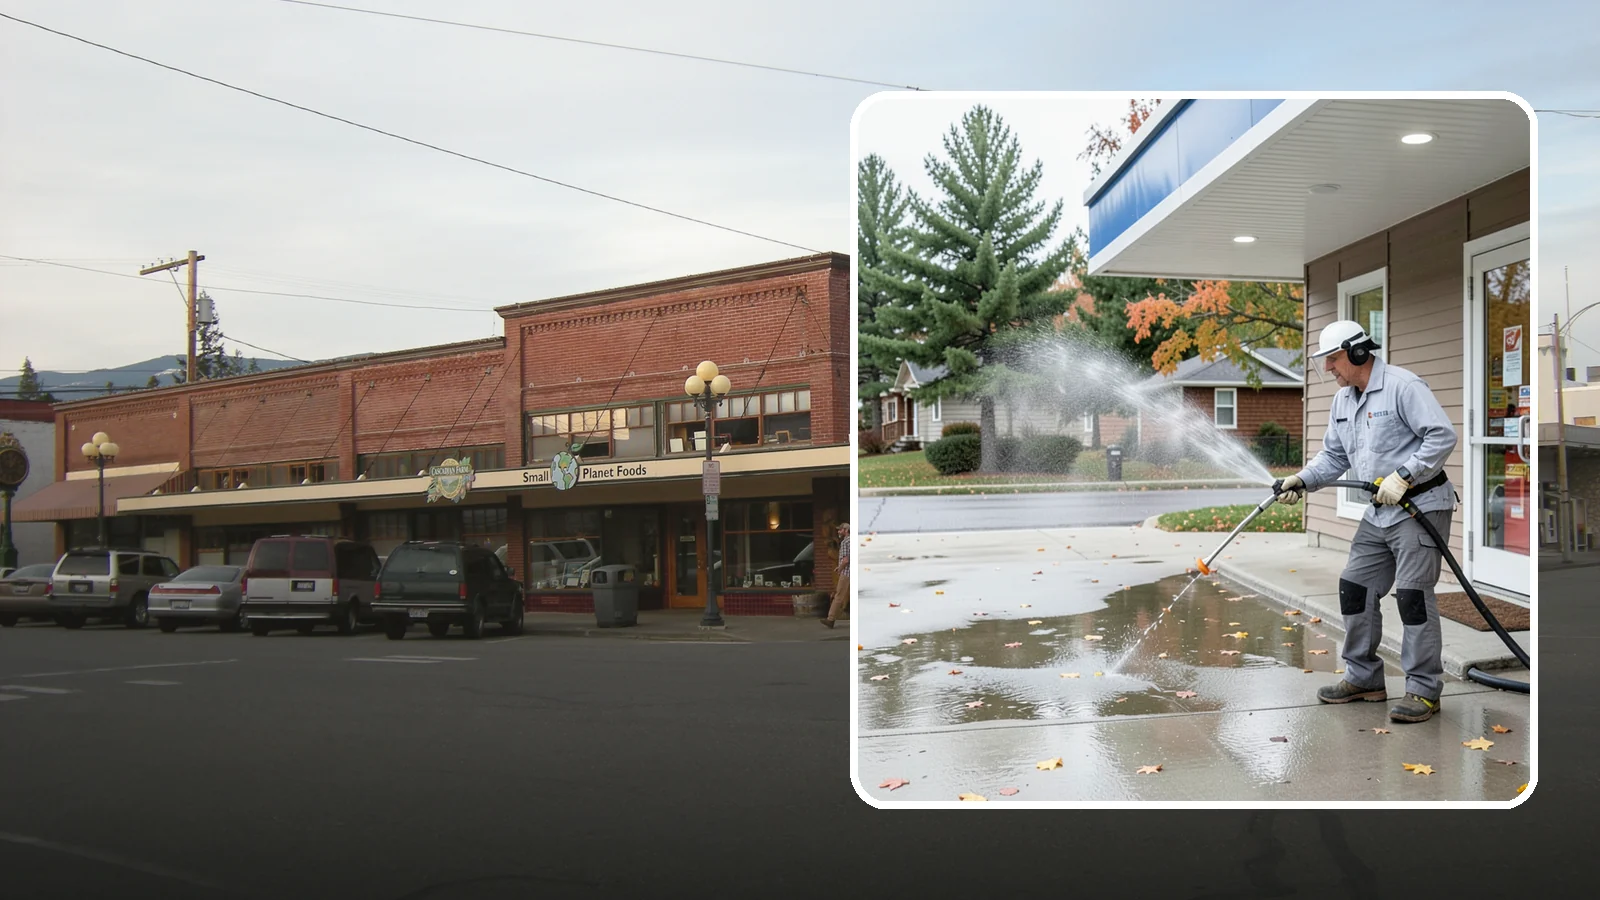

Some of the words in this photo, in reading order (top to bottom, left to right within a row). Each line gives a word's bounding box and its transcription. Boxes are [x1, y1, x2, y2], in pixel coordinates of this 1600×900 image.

[523, 471, 548, 482] Small
[583, 468, 614, 479] Planet
[617, 464, 647, 476] Foods
